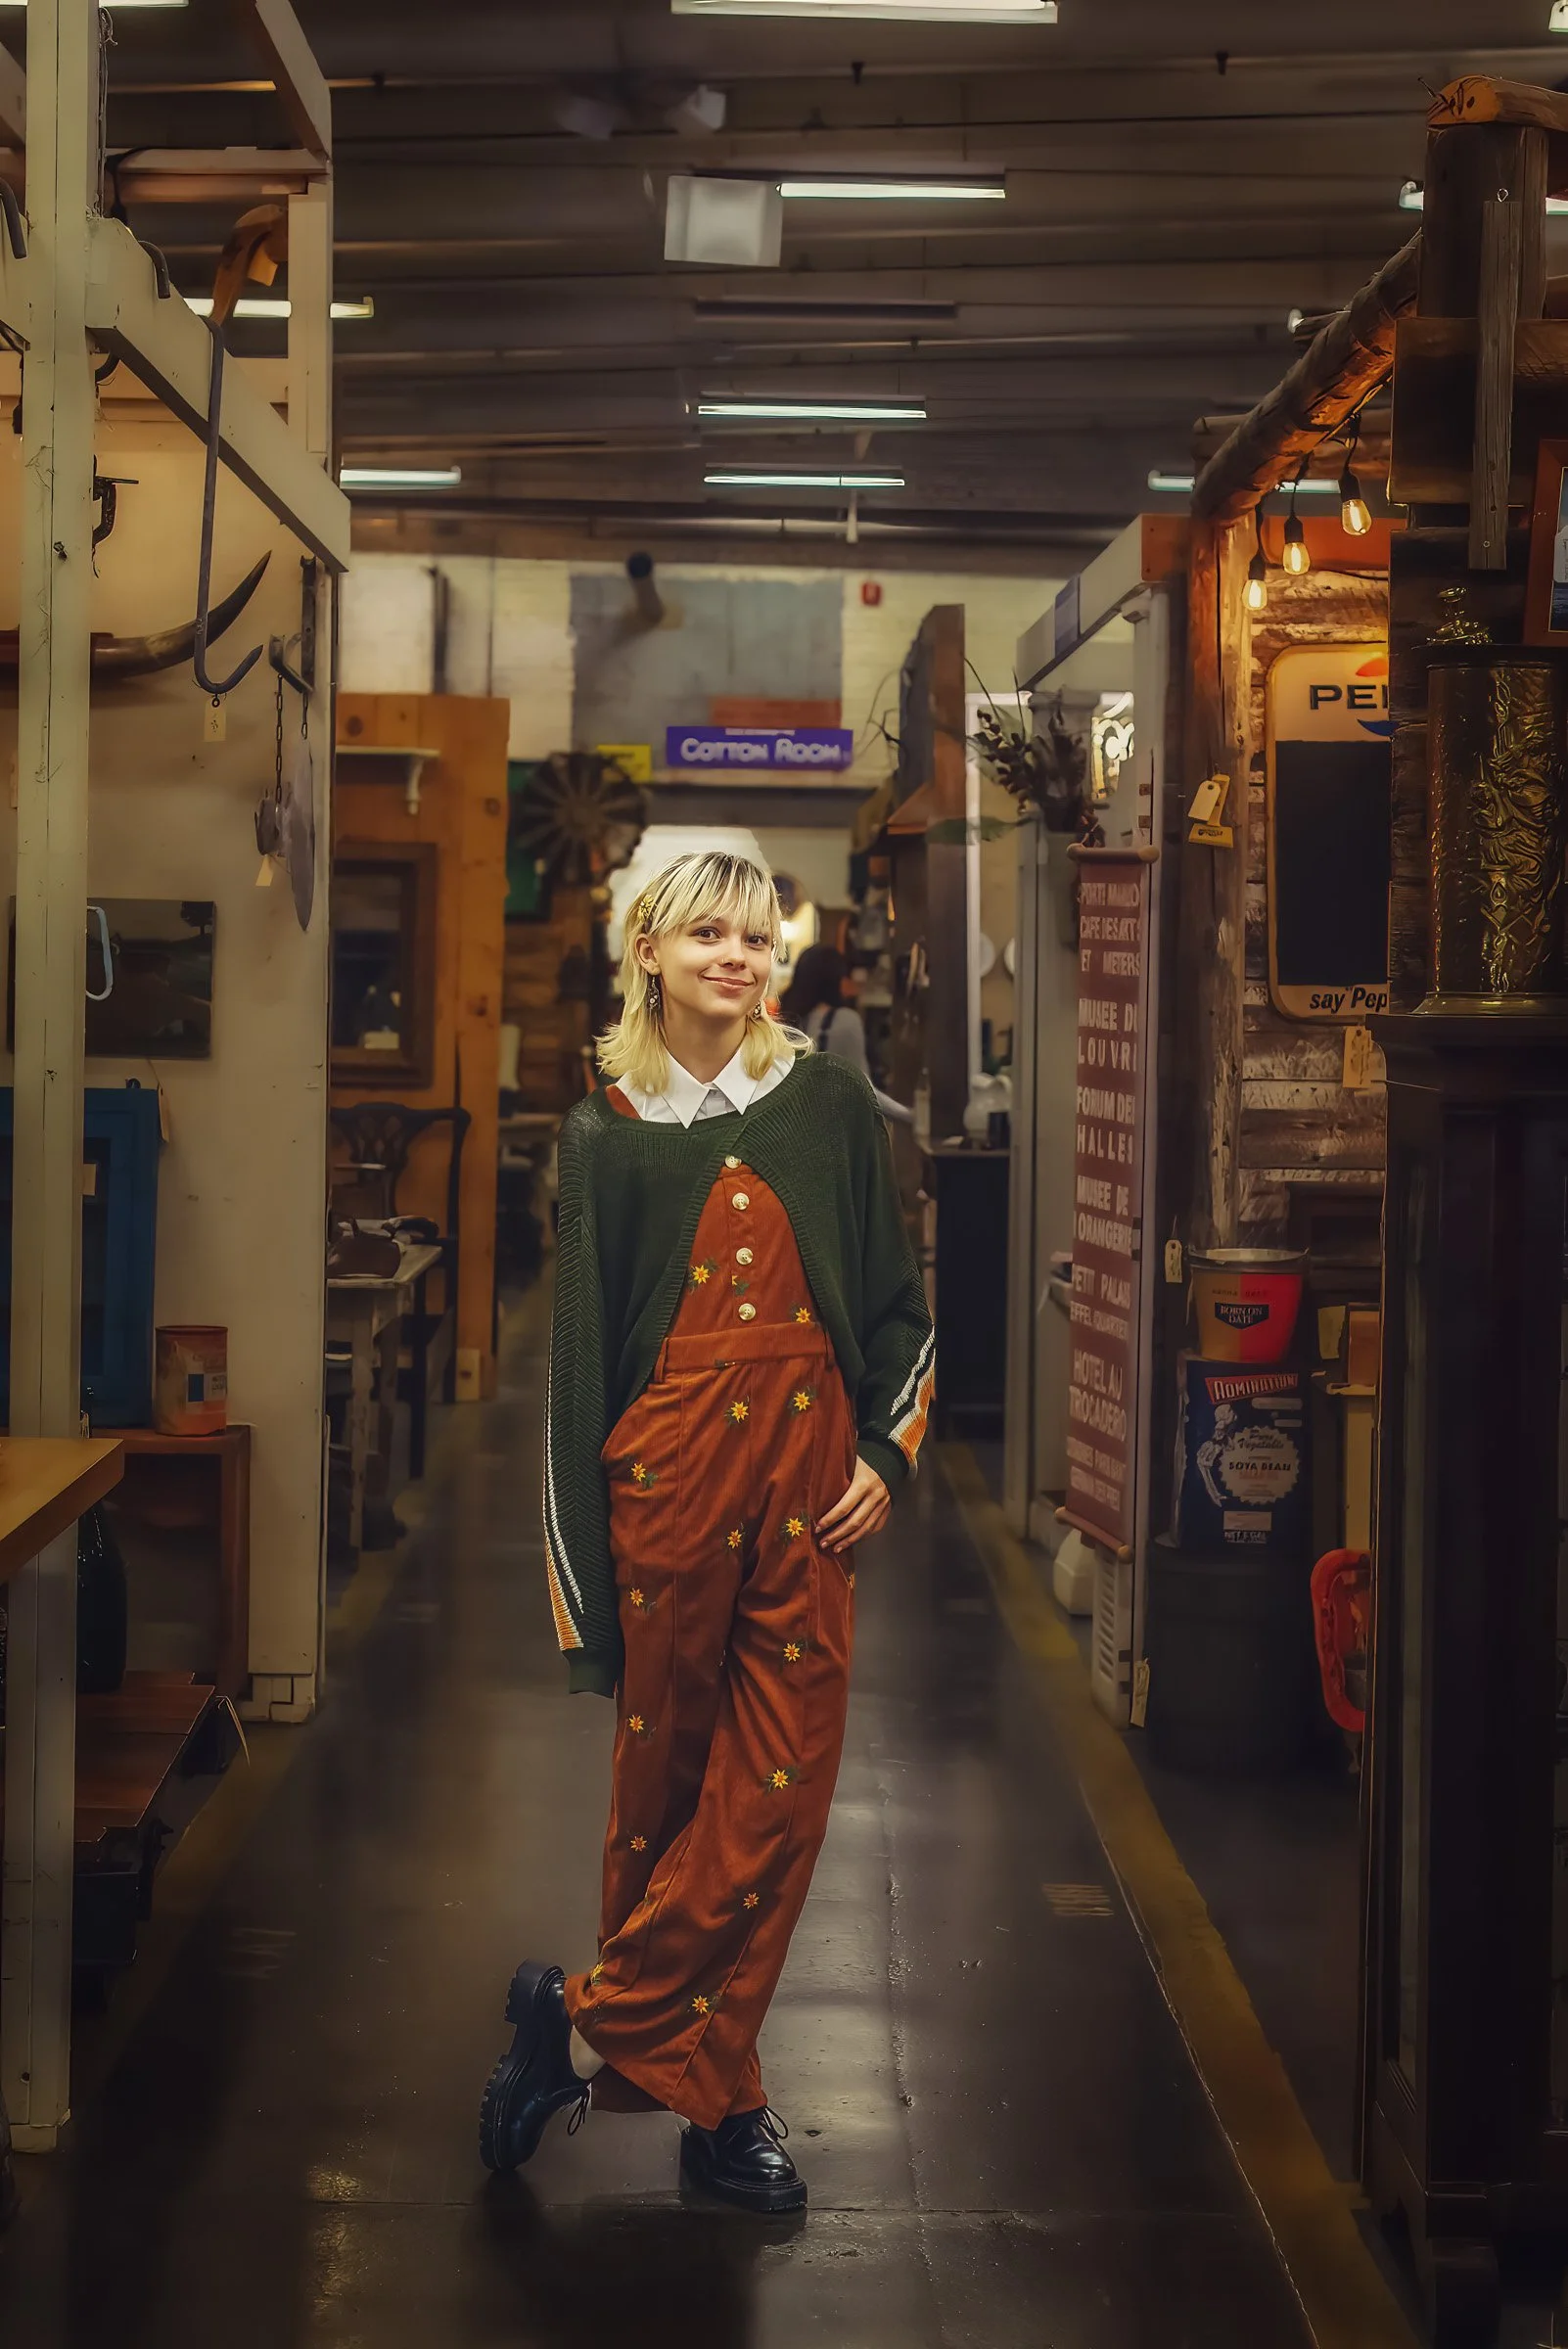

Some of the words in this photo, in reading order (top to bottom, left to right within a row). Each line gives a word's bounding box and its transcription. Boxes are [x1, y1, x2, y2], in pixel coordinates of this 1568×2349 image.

[1310, 992, 1346, 1014] say
[1077, 1085, 1115, 1121] FORUM
[1073, 1349, 1106, 1394] HOTEL
[1228, 1461, 1259, 1471] SOYA
